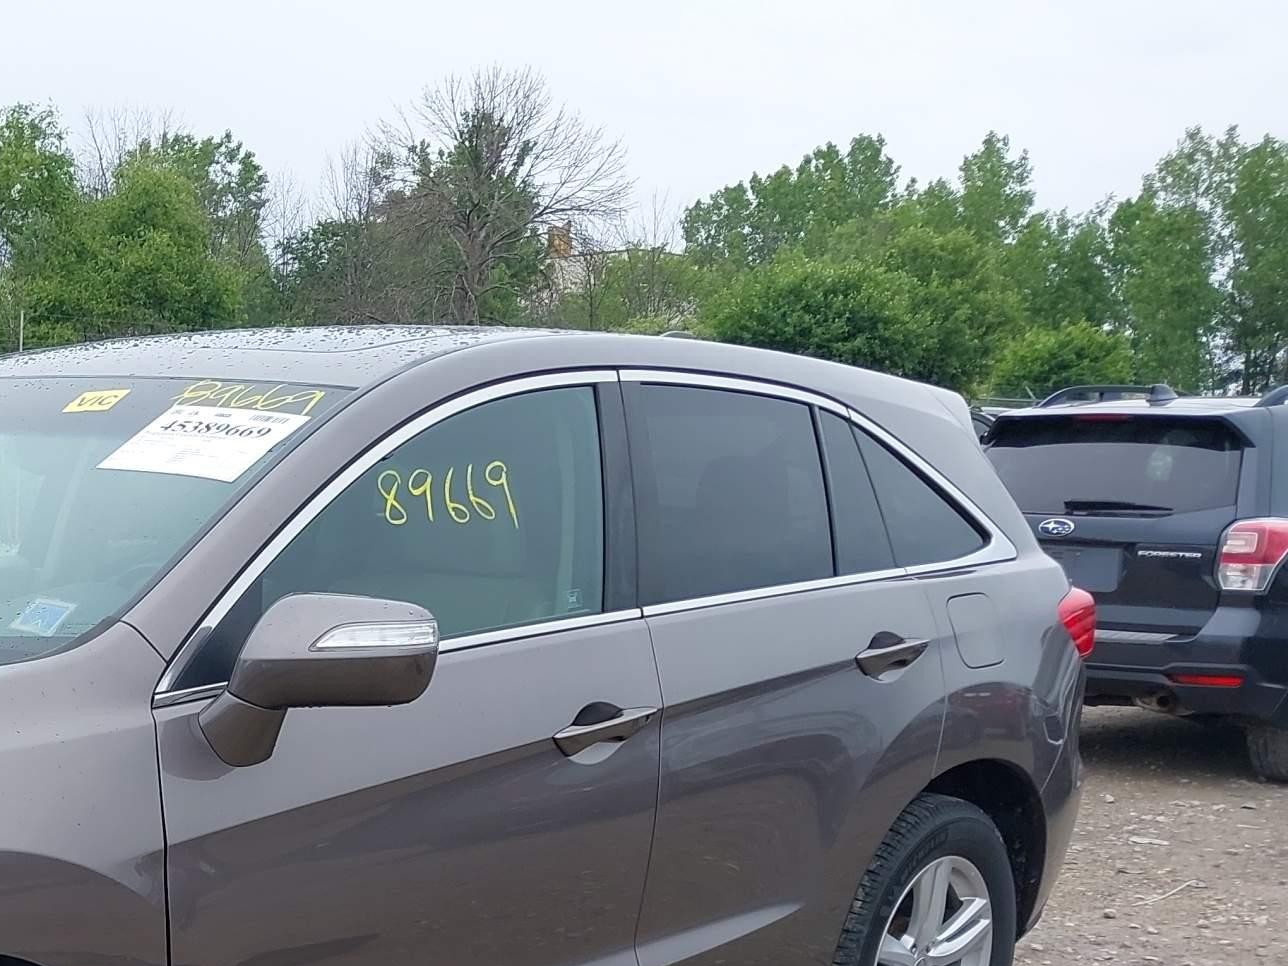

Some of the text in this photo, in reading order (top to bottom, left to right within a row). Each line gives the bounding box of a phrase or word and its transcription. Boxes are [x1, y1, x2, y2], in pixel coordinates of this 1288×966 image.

[76, 394, 120, 408] VIC
[159, 419, 273, 439] 45389669
[377, 460, 520, 530] 89669
[1137, 550, 1202, 559] FORESTER
